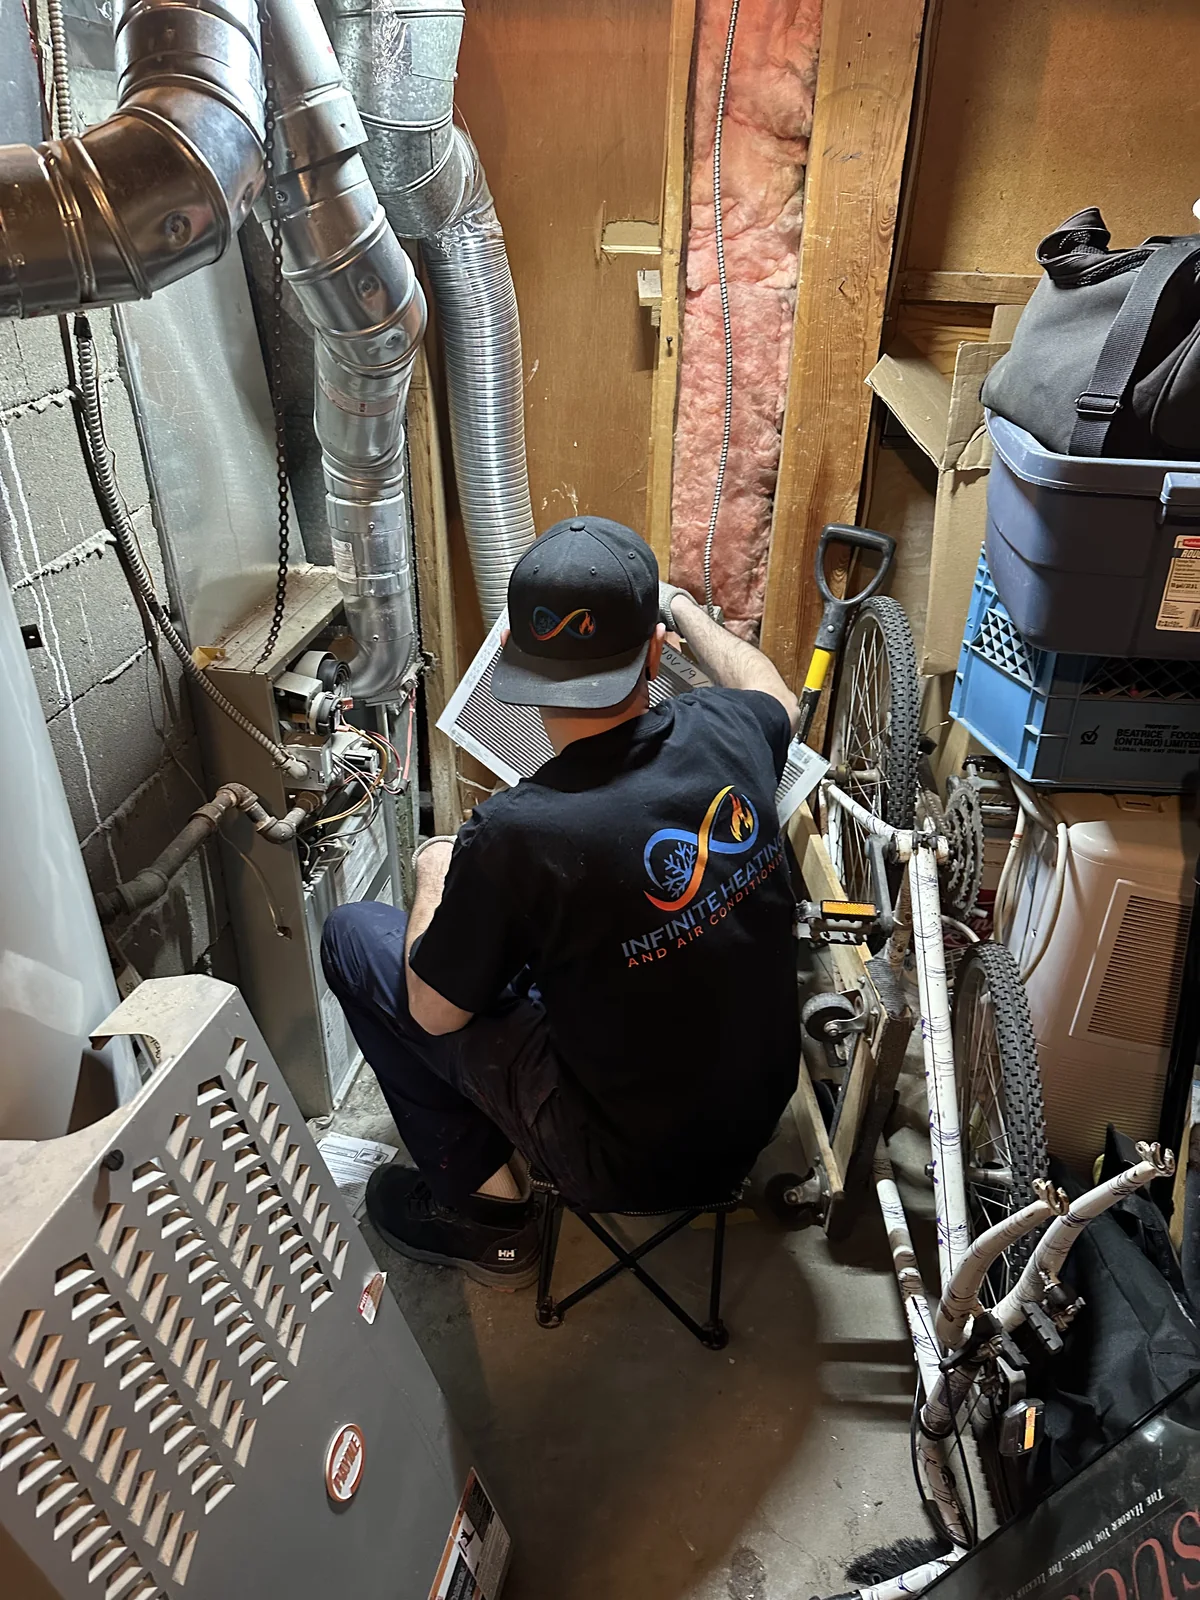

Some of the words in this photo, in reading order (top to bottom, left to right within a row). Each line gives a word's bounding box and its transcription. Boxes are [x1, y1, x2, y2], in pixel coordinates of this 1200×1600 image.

[1116, 728, 1164, 738] BEATRICE
[1114, 737, 1163, 748] (ONTARIO)
[628, 947, 668, 968] AND
[677, 925, 704, 949] AIR
[709, 851, 785, 926] CONDITIONIN
[620, 890, 722, 958] INFINITE
[498, 1249, 515, 1258] HH
[1145, 1488, 1165, 1507] THE
[1110, 1502, 1145, 1531] HARDER
[1094, 1527, 1111, 1544] YOU
